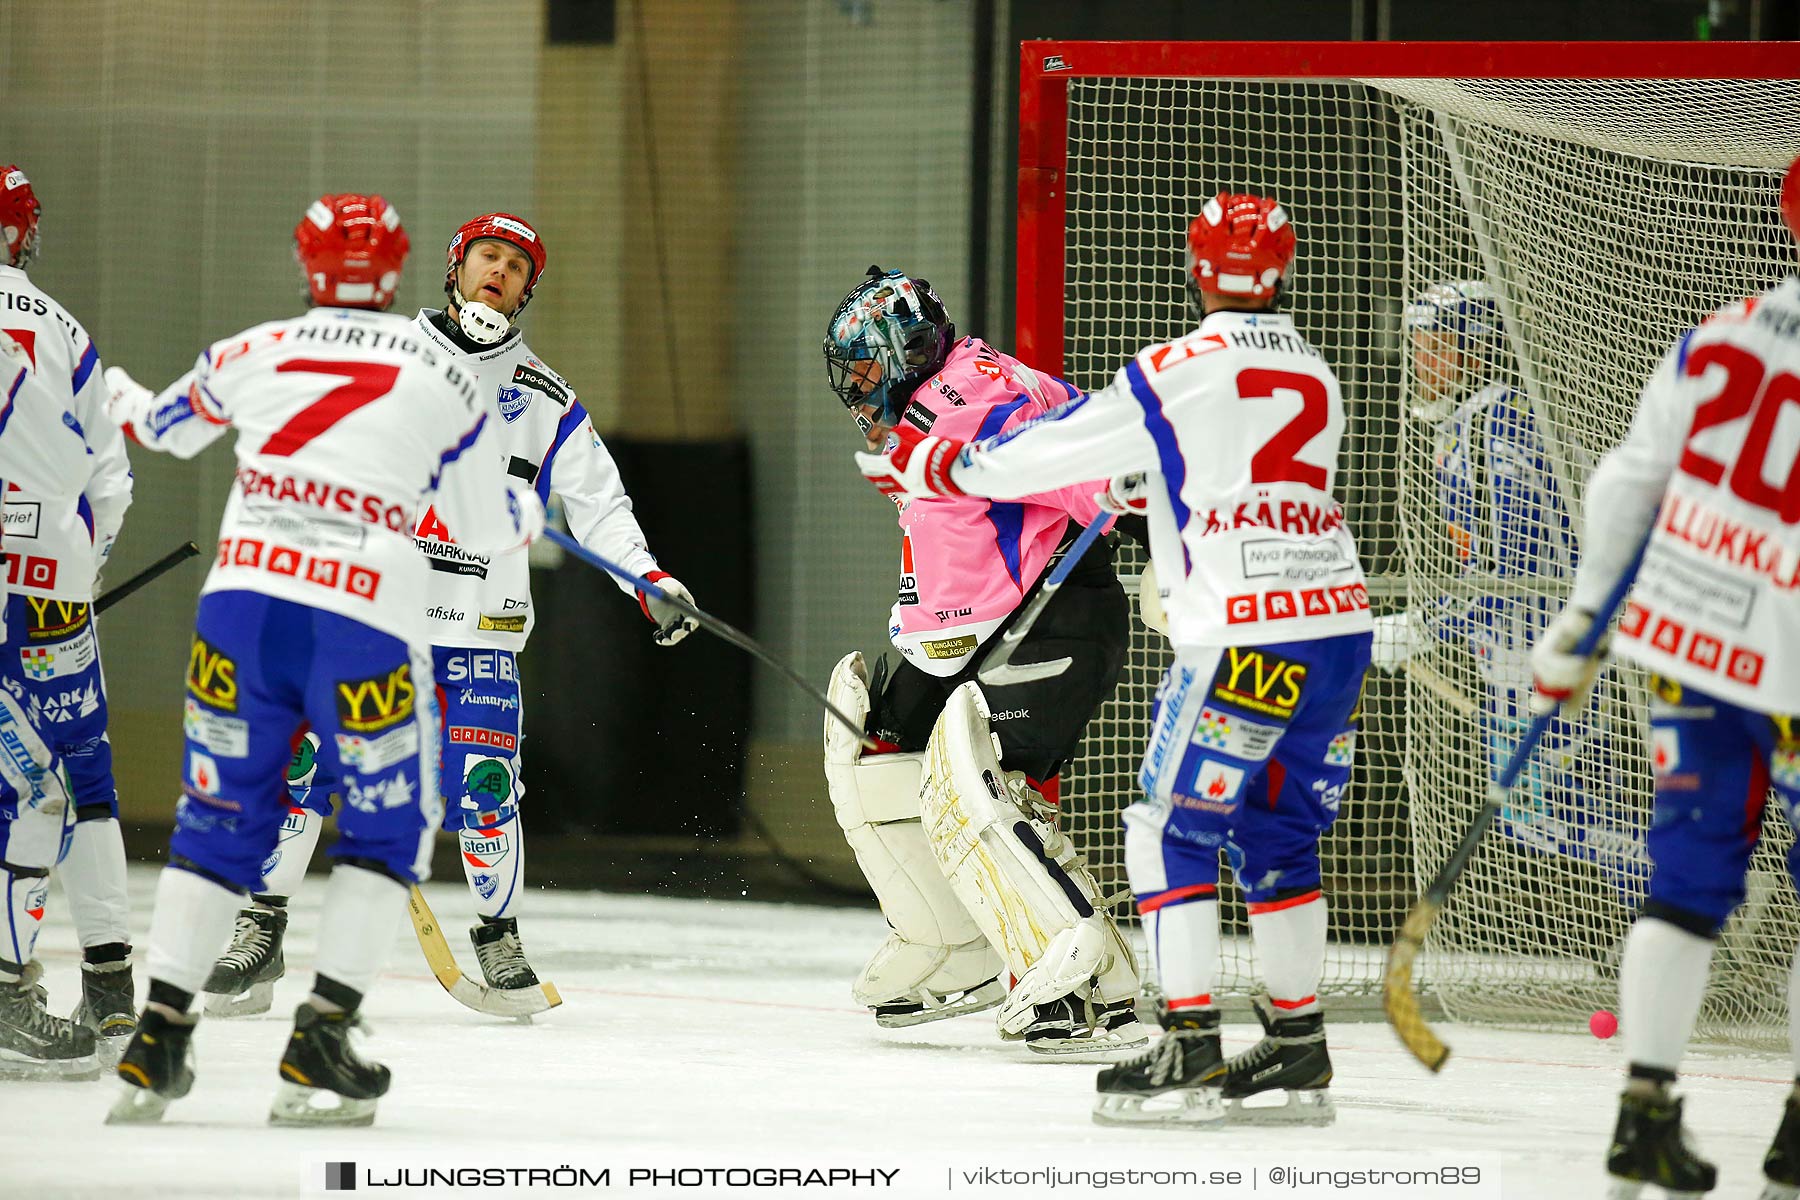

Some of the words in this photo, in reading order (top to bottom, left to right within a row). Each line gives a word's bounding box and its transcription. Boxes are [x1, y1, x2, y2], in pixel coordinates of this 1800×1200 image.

[257, 358, 402, 457] 7
[1235, 368, 1329, 491] 2
[339, 662, 416, 721] YVS
[447, 655, 514, 681] SEB
[1224, 646, 1307, 707] YVS
[450, 727, 516, 749] CRAMO
[464, 837, 502, 854] steni
